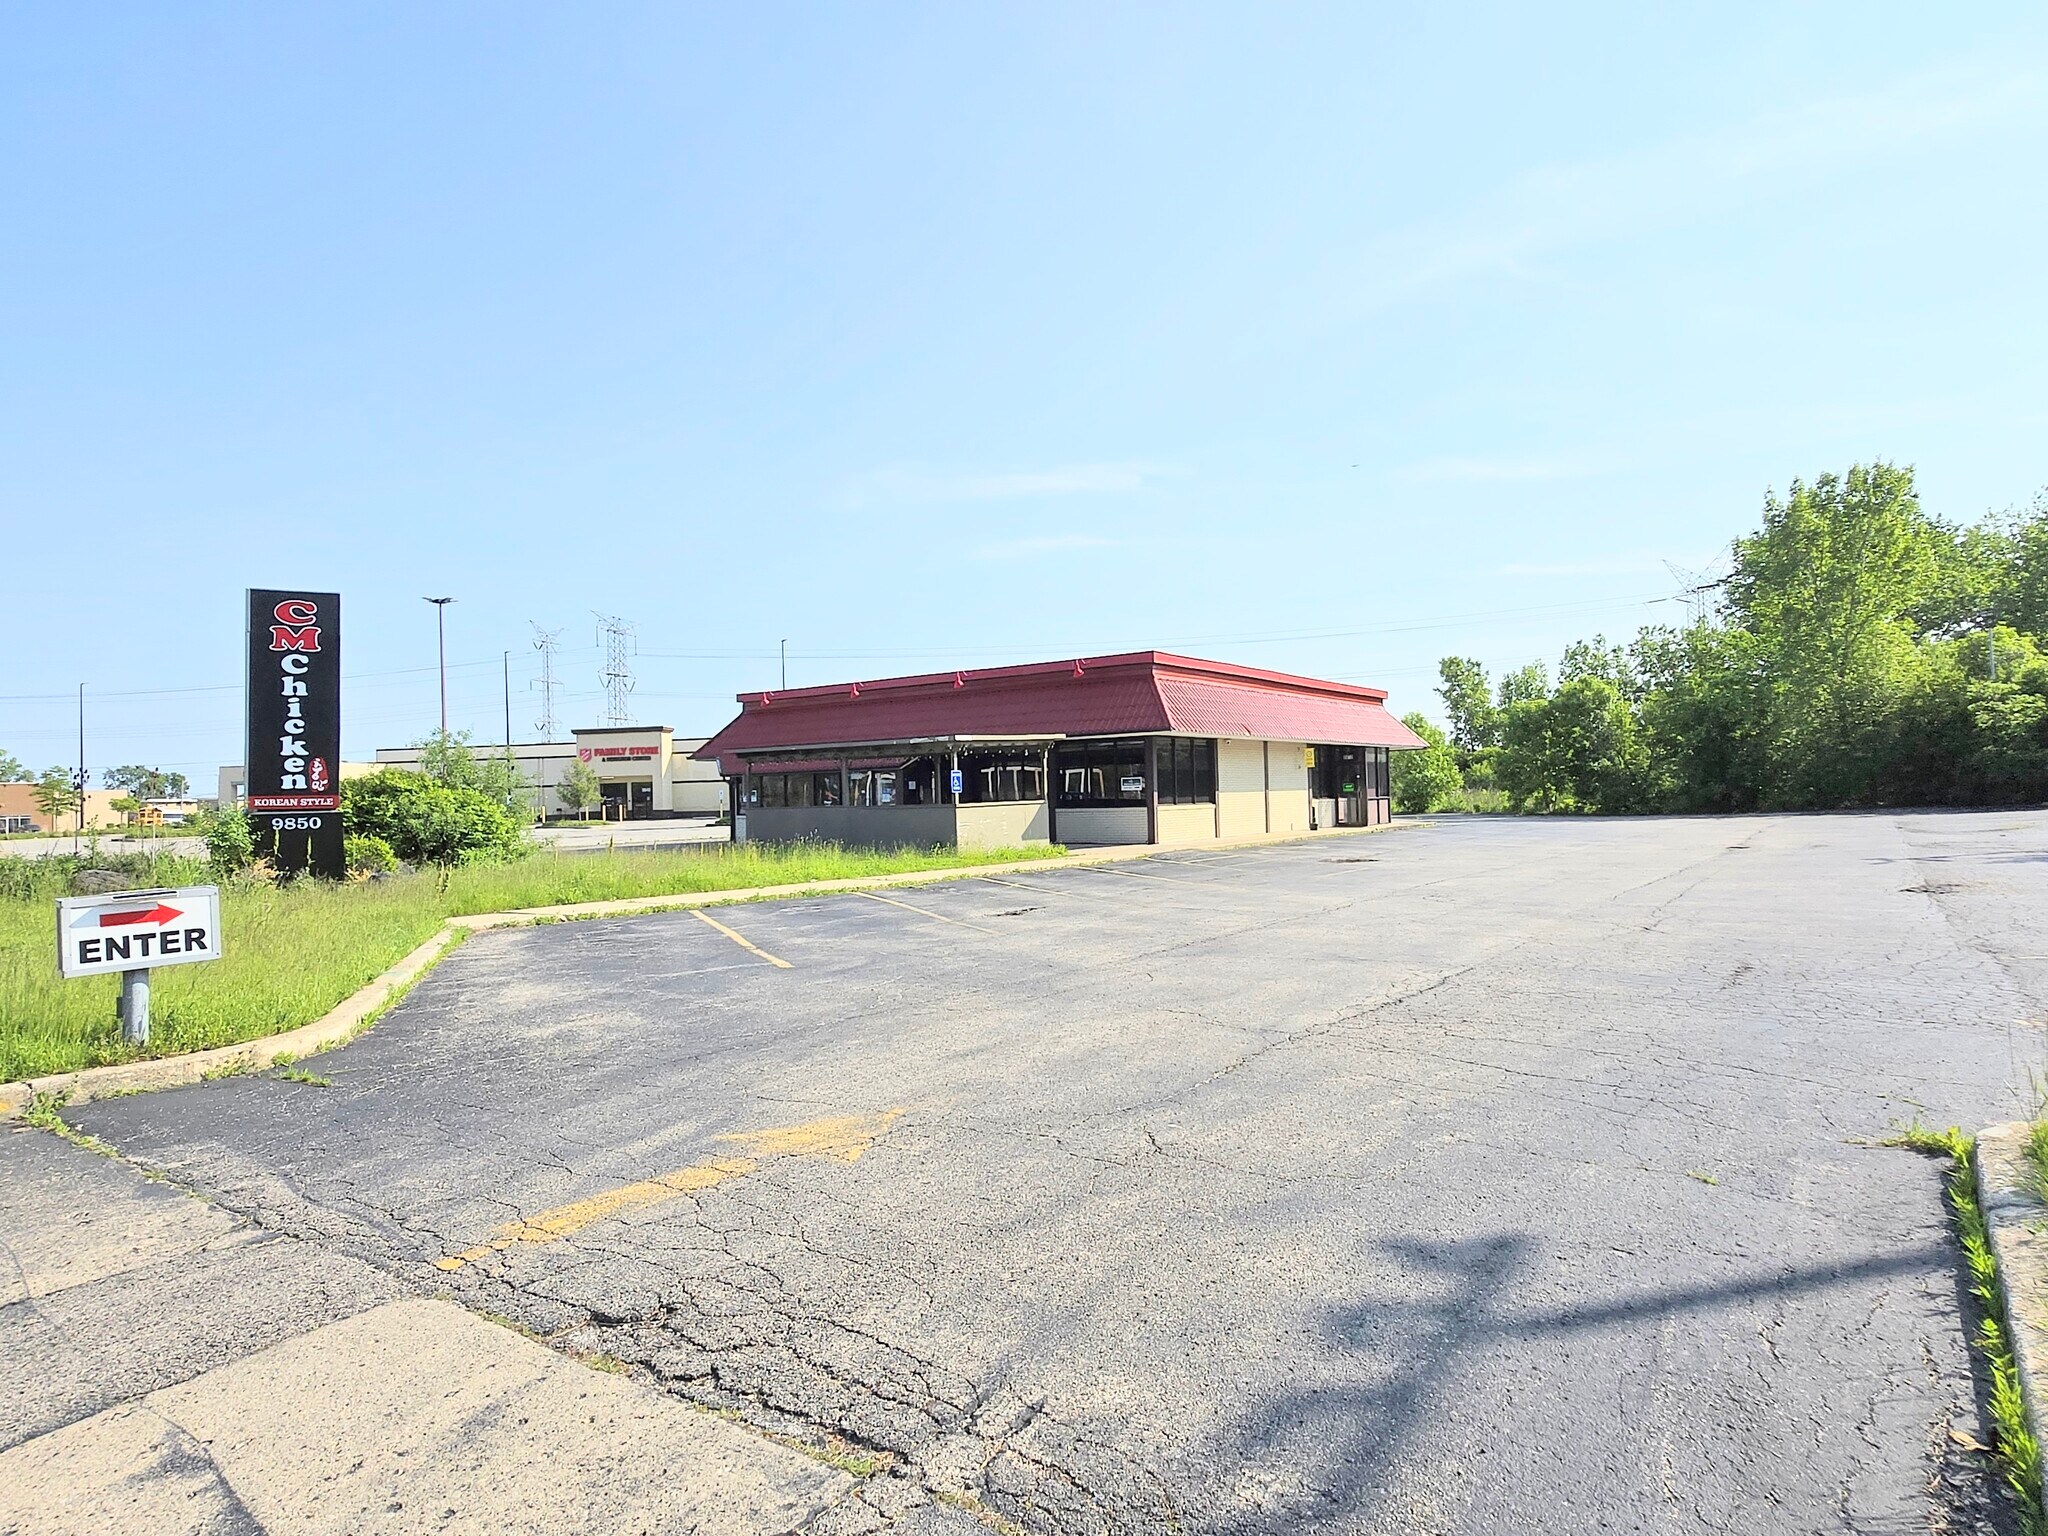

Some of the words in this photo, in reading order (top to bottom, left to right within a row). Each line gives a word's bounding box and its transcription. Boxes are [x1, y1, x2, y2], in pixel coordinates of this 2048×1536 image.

[269, 600, 321, 652] CM
[280, 653, 308, 790] Chicken
[629, 746, 659, 755] STORE
[254, 798, 298, 807] KOREAN
[300, 798, 334, 806] STYLE
[271, 816, 322, 831] 9850
[78, 928, 208, 964] ENTER
